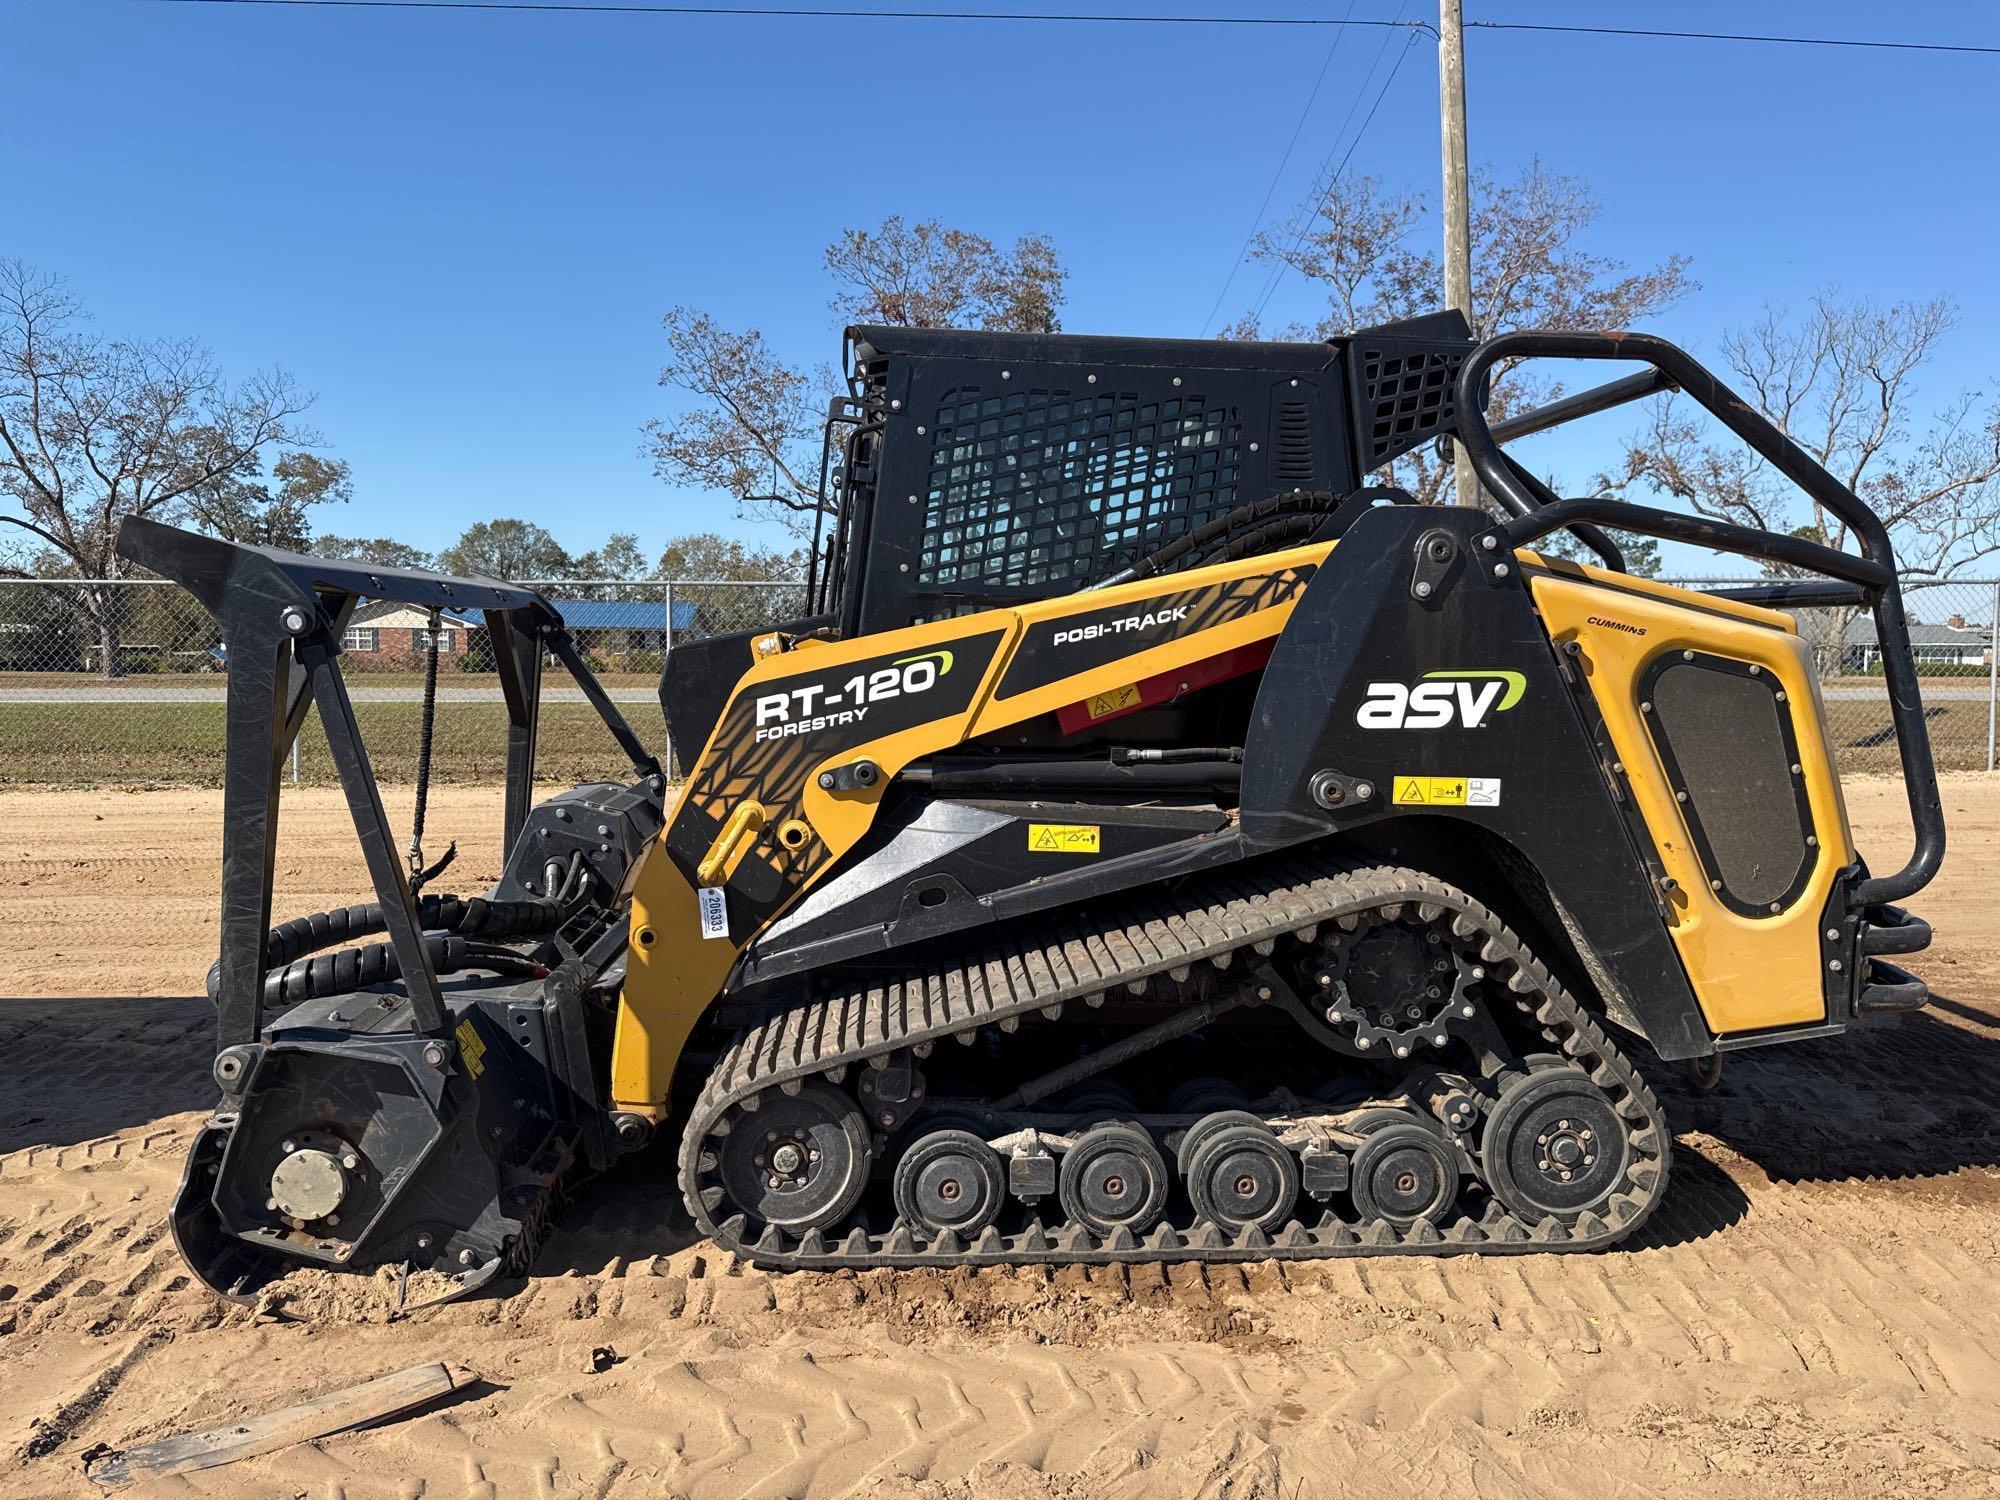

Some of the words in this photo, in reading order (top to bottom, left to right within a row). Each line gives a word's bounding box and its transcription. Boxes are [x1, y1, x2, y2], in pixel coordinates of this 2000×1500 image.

[1053, 606, 1188, 646] POSI-TRACK
[1587, 616, 1647, 636] CUMMINS
[755, 661, 936, 727] RT-120
[755, 707, 869, 743] FORESTRY
[709, 897, 723, 932] 206333
